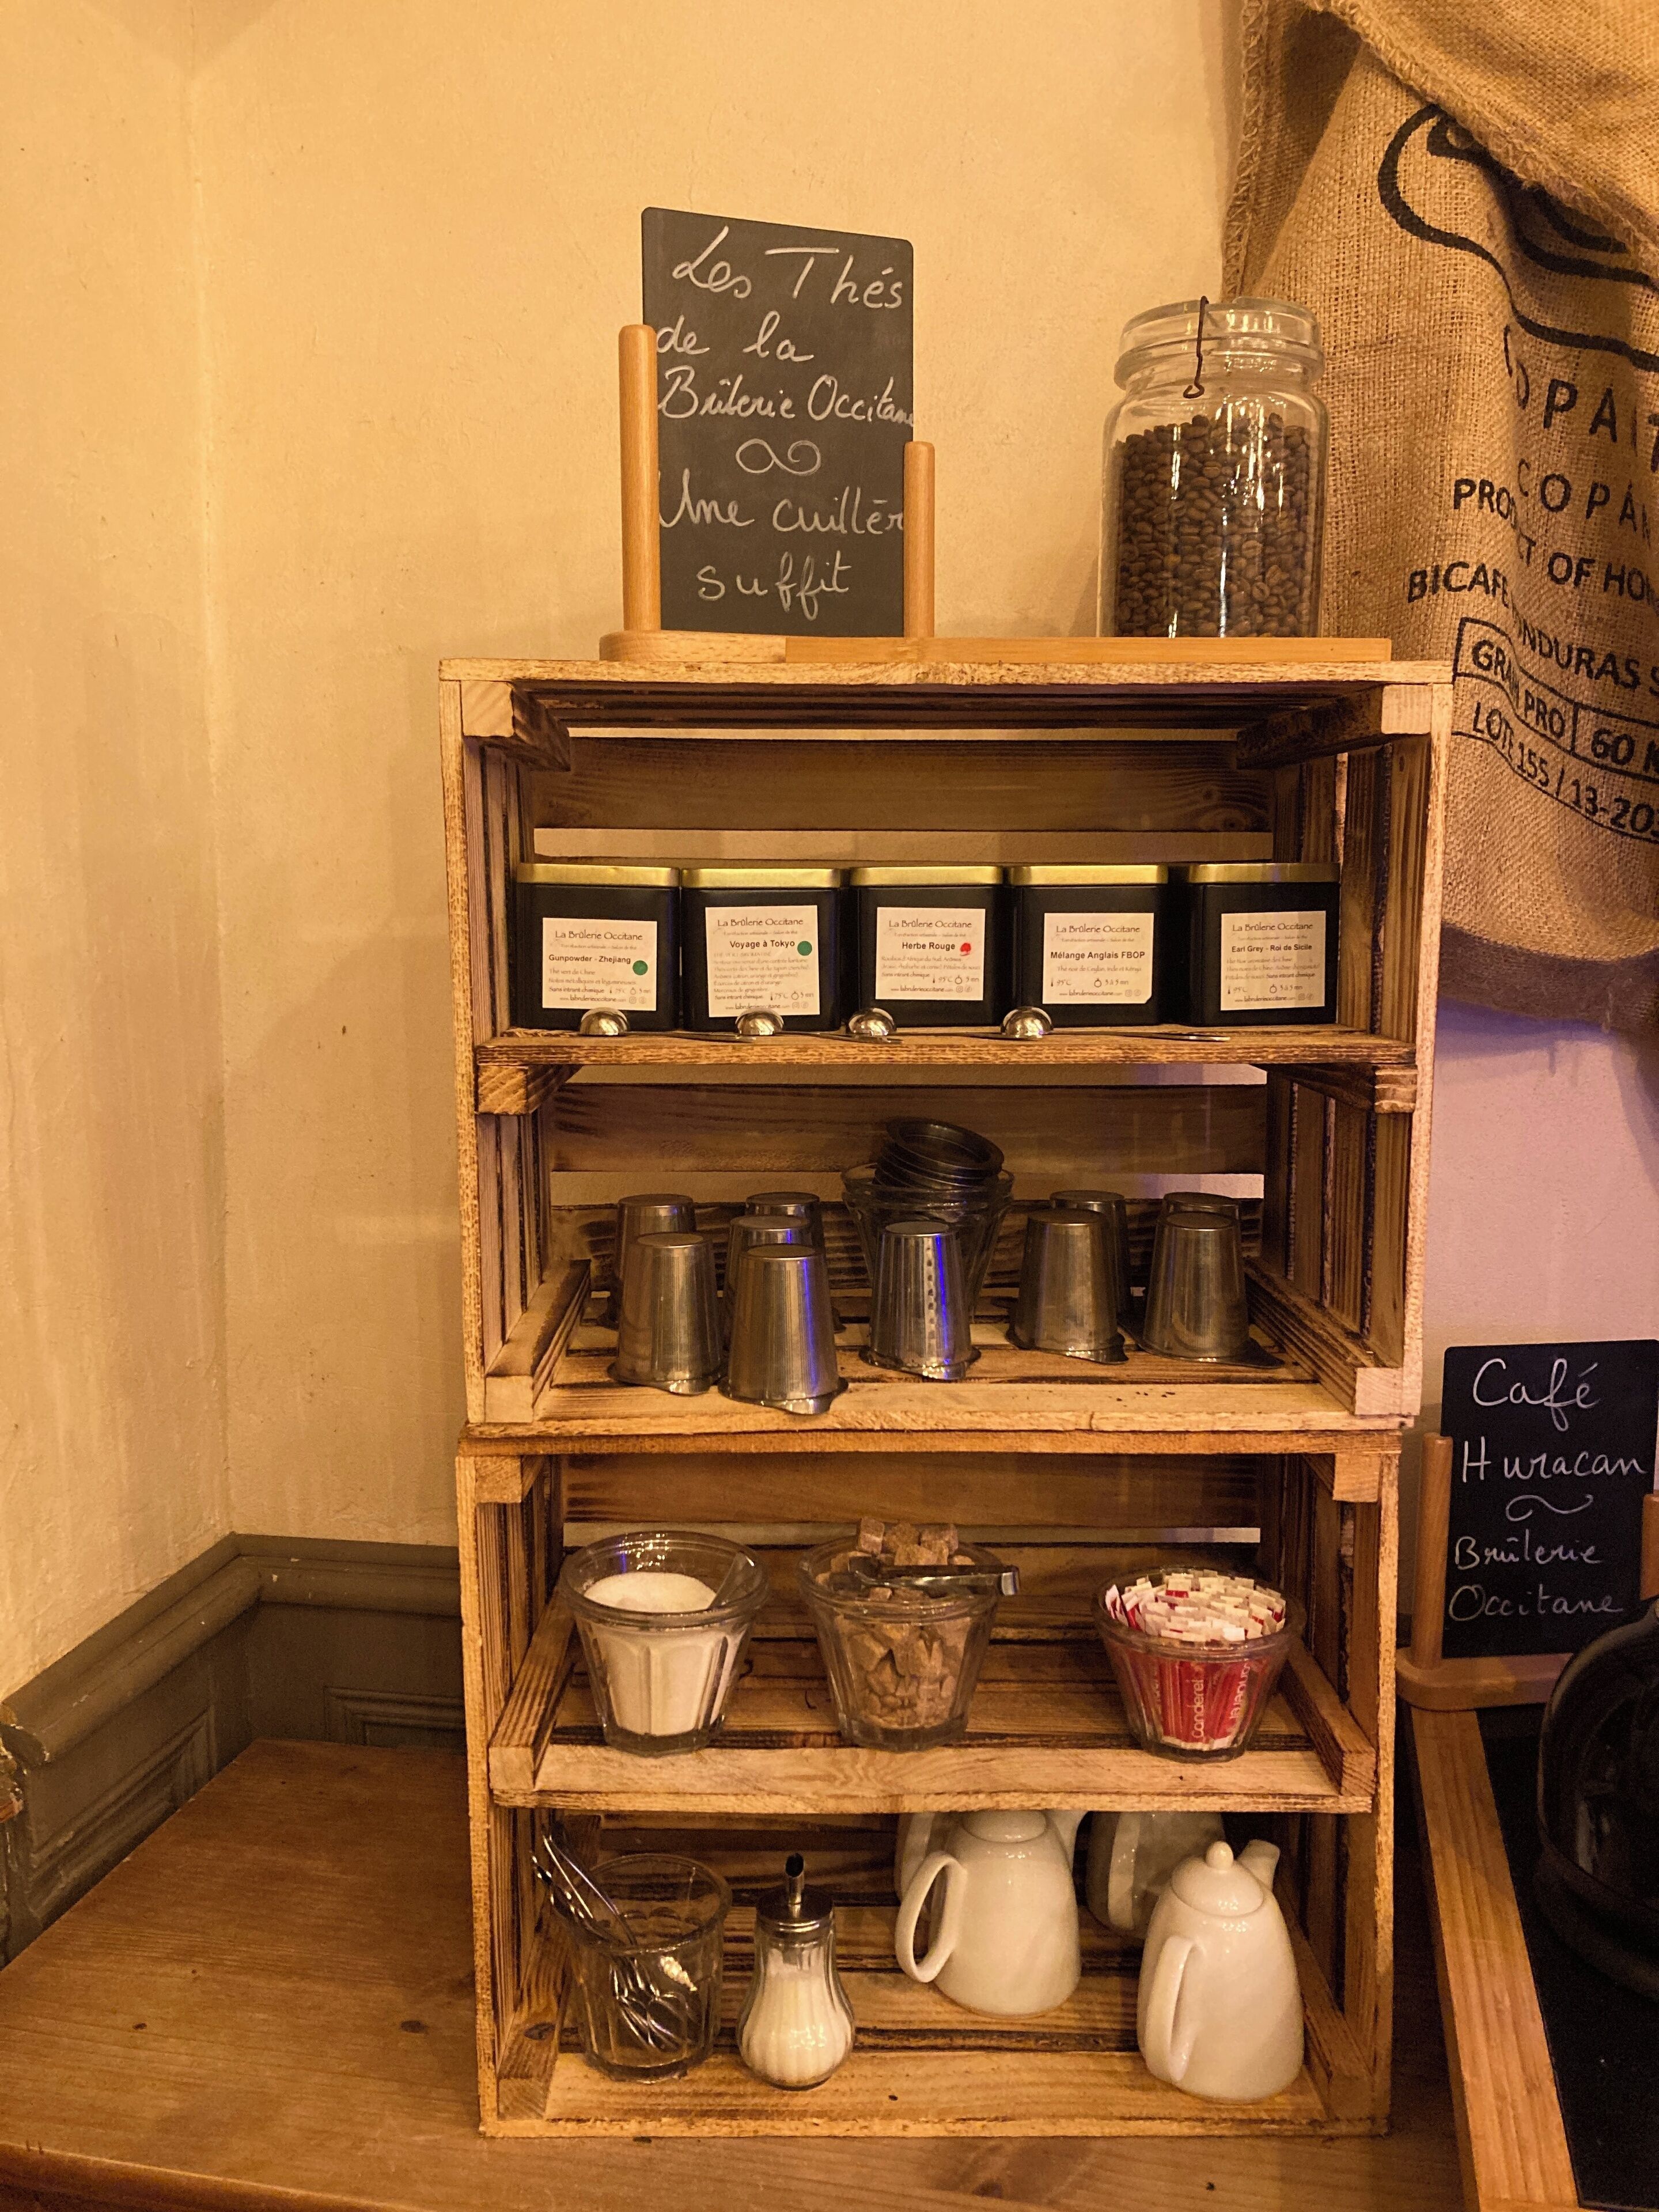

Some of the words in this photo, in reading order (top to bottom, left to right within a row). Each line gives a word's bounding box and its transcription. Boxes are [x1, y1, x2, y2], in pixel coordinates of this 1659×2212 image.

[672, 226, 751, 299] Les
[765, 247, 903, 309] Thés
[657, 315, 710, 355] de
[743, 310, 814, 362] la
[698, 550, 851, 621] suffit
[1547, 552, 1595, 588] OF
[1524, 690, 1566, 740] PRO
[1591, 728, 1635, 766] 60
[555, 930, 566, 938] La
[569, 929, 601, 940] Brûlerie
[604, 931, 643, 941] Occitane
[717, 919, 728, 927] La
[730, 917, 763, 926] Brûlerie
[902, 918, 933, 927] Brûlerie
[1069, 923, 1101, 933] Brûlerie
[1232, 924, 1243, 932] La
[549, 954, 592, 963] Gunpowder
[599, 955, 631, 964] Zhejiang
[729, 941, 760, 949] Voyage
[770, 940, 795, 949] Tokyo
[929, 942, 955, 952] Rouge
[1051, 951, 1085, 960] Mélange
[1088, 951, 1119, 960] Anglais
[1247, 945, 1263, 953] Grey
[1472, 1358, 1600, 1431] Café
[1462, 1435, 1647, 1483] Huracan
[1455, 1529, 1604, 1570] Brûlerie
[1449, 1584, 1623, 1622] Occitane
[1187, 1677, 1205, 1738] Canderel
